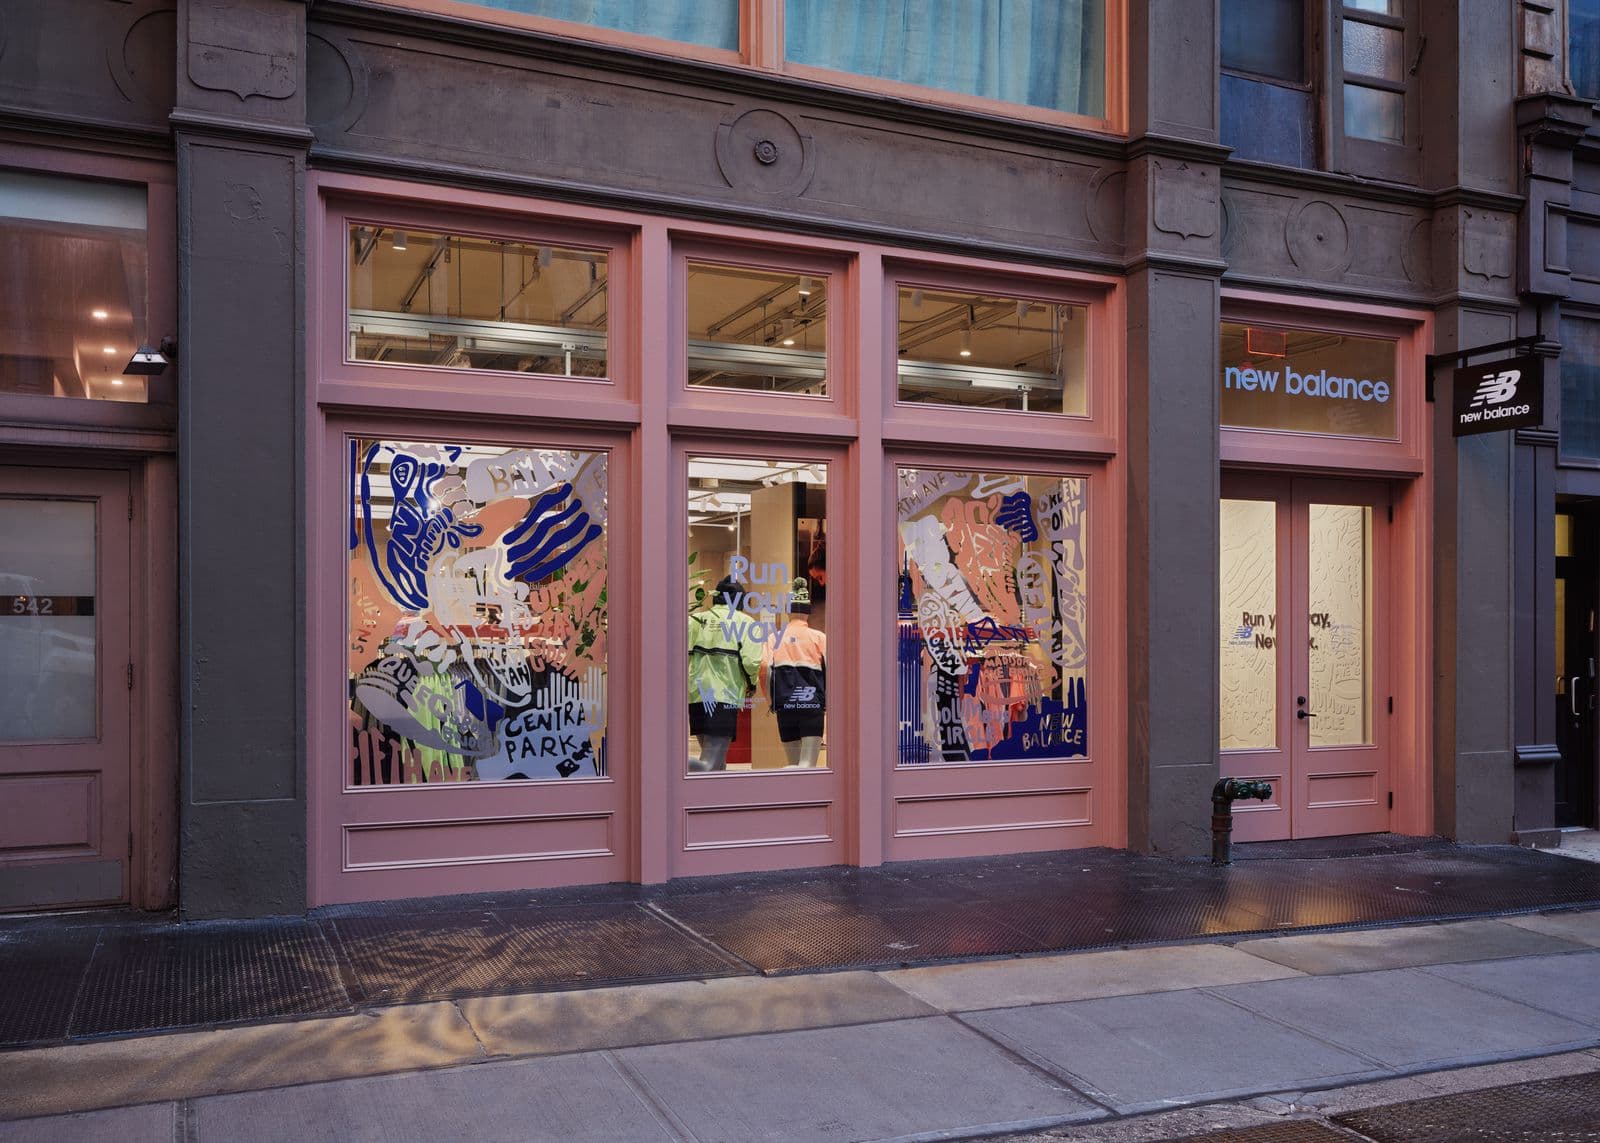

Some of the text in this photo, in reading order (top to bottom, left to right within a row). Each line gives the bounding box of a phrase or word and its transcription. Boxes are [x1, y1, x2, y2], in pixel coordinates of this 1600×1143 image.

[1225, 366, 1390, 403] new balance
[1460, 404, 1530, 423] new balance
[729, 556, 788, 585] Run
[13, 598, 52, 614] 542
[723, 591, 794, 619] your
[720, 620, 797, 650] way.
[1242, 612, 1264, 627] Run
[1309, 613, 1331, 630] ay,
[1040, 712, 1074, 732] NEW
[505, 735, 577, 763] PARK
